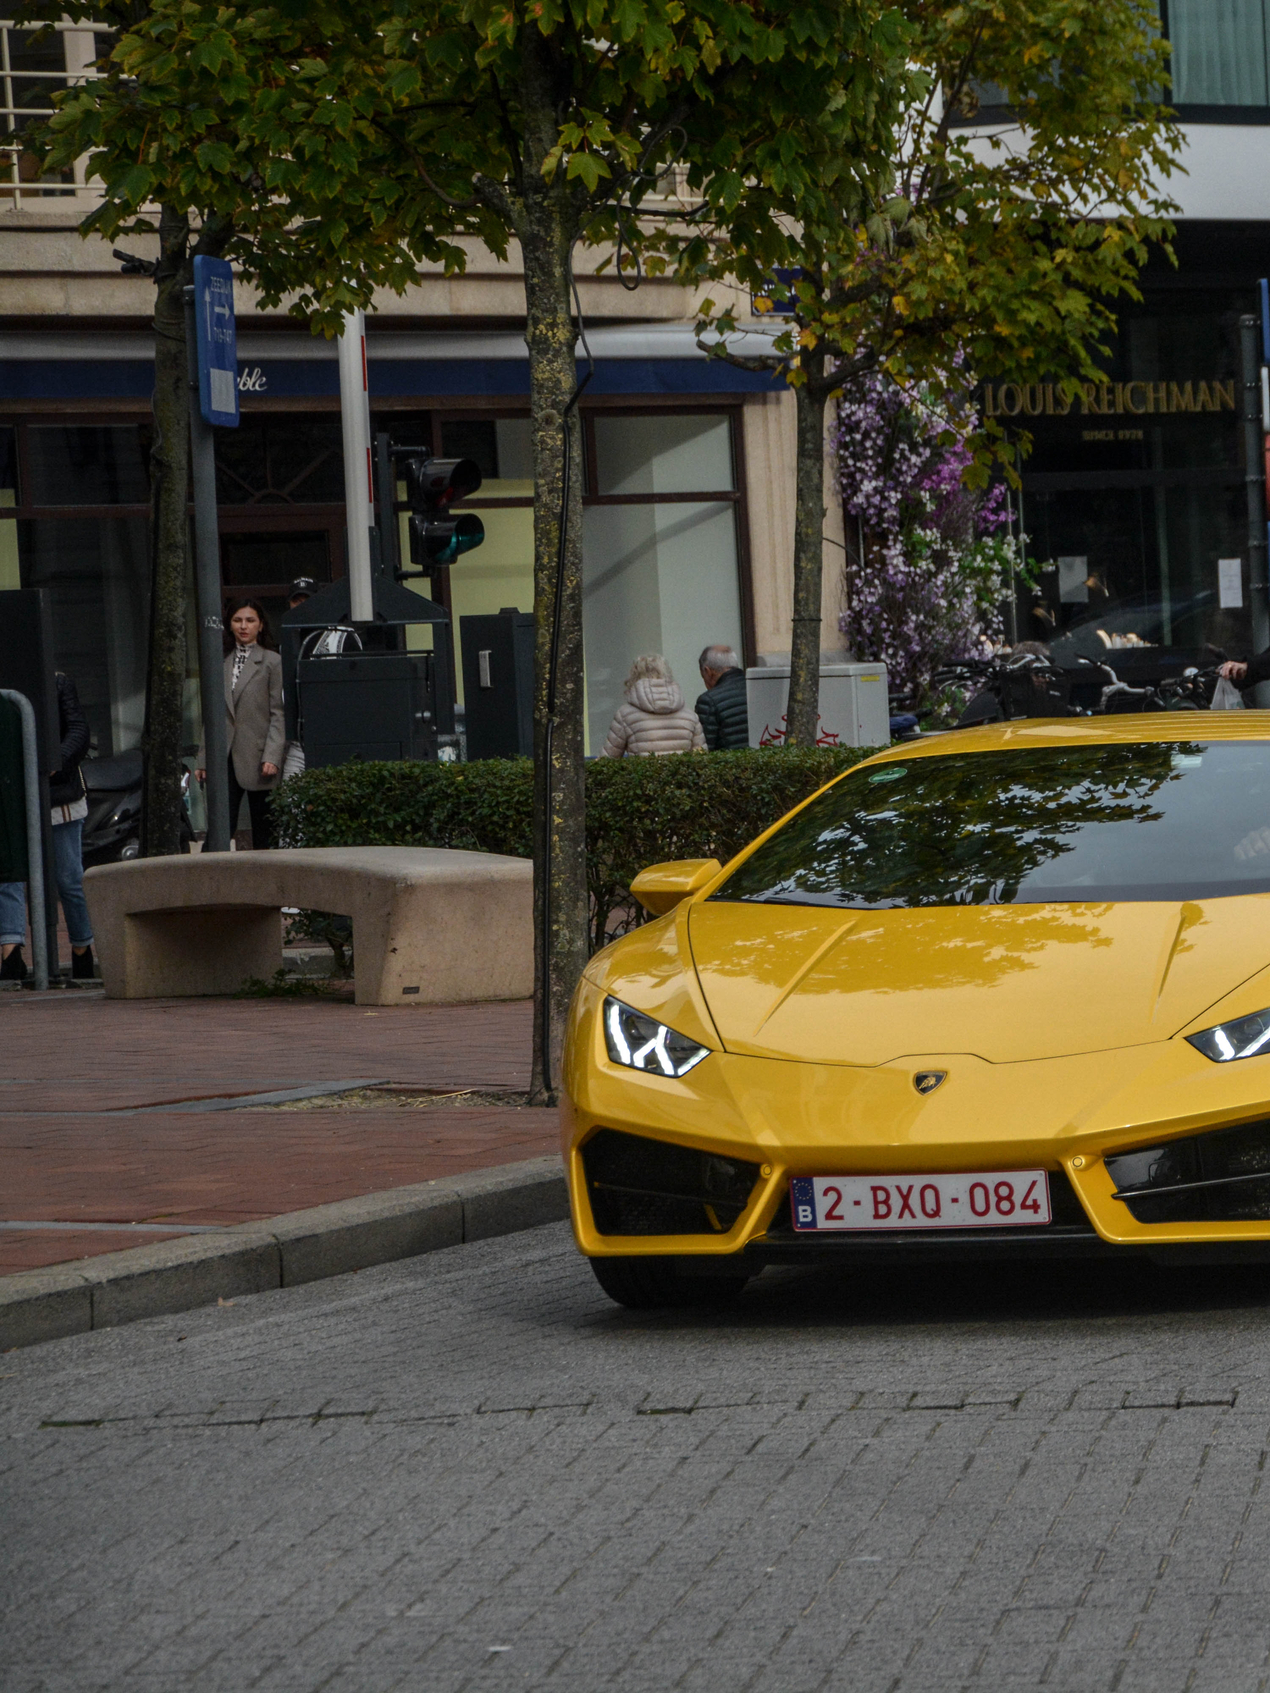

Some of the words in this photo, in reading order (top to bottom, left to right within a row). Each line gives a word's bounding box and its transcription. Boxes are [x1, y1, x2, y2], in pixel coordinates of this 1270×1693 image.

[984, 382, 1071, 416] LOUIS
[1080, 379, 1236, 415] REICHMAN
[797, 1205, 813, 1222] B
[822, 1180, 1041, 1221] 2-BXQ-084
